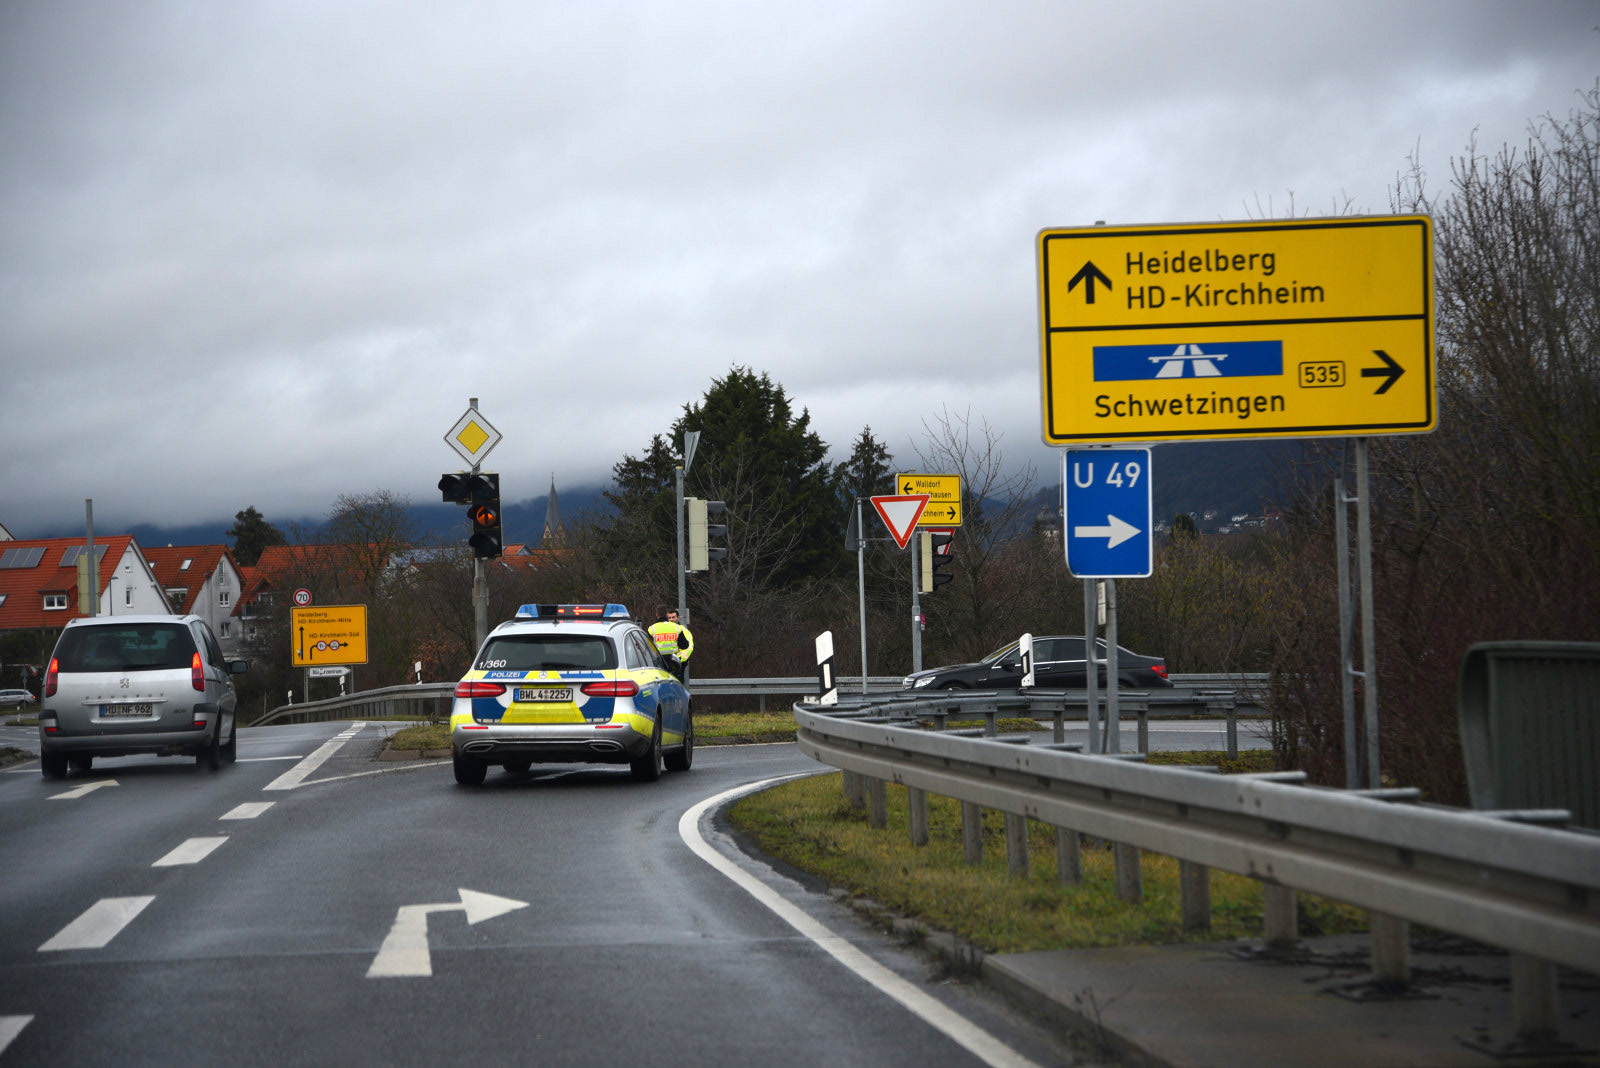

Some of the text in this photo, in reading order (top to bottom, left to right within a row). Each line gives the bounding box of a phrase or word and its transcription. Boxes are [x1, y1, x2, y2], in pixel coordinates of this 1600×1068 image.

[1126, 249, 1276, 276] Heidelberg
[1127, 281, 1325, 310] HD-Kirchheim
[1304, 365, 1340, 384] 535
[1095, 391, 1285, 419] Schwetzingen
[1074, 462, 1141, 488] U 49
[916, 480, 941, 488] Walldorf
[298, 594, 308, 602] 70
[479, 660, 507, 669] 1/360
[519, 689, 570, 700] BWL 4 2257
[105, 704, 151, 714] HD NF 962
